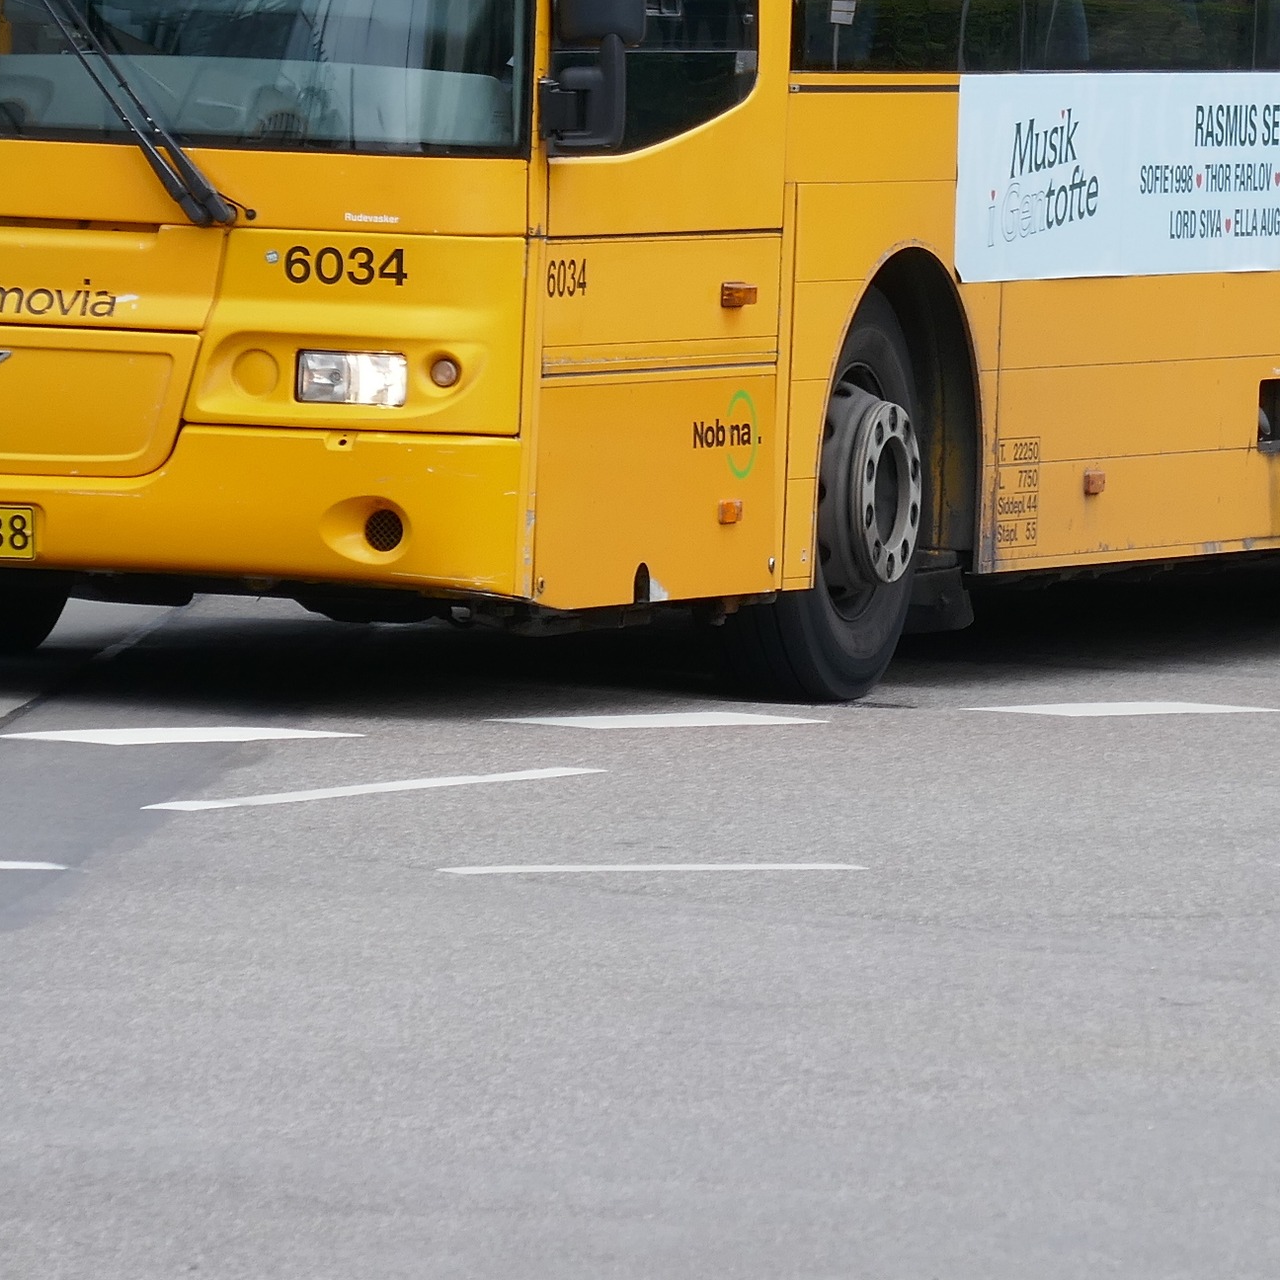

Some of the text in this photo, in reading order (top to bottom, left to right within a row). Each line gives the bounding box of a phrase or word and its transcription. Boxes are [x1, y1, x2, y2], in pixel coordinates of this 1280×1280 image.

[1009, 108, 1080, 179] Musik
[1194, 104, 1258, 148] RASMUS
[1139, 164, 1194, 195] SOFIE1998
[1205, 163, 1232, 193] THOR
[1234, 162, 1273, 192] FARLOV
[1001, 165, 1100, 243] Gentofte
[1169, 210, 1197, 239] LORD
[1199, 209, 1222, 239] SIVA
[1233, 208, 1258, 238] ELLA
[282, 245, 409, 287] 6034
[546, 258, 587, 298] 6034
[1018, 468, 1038, 488] 7750
[1026, 494, 1038, 513] 44
[1025, 521, 1037, 541] 55
